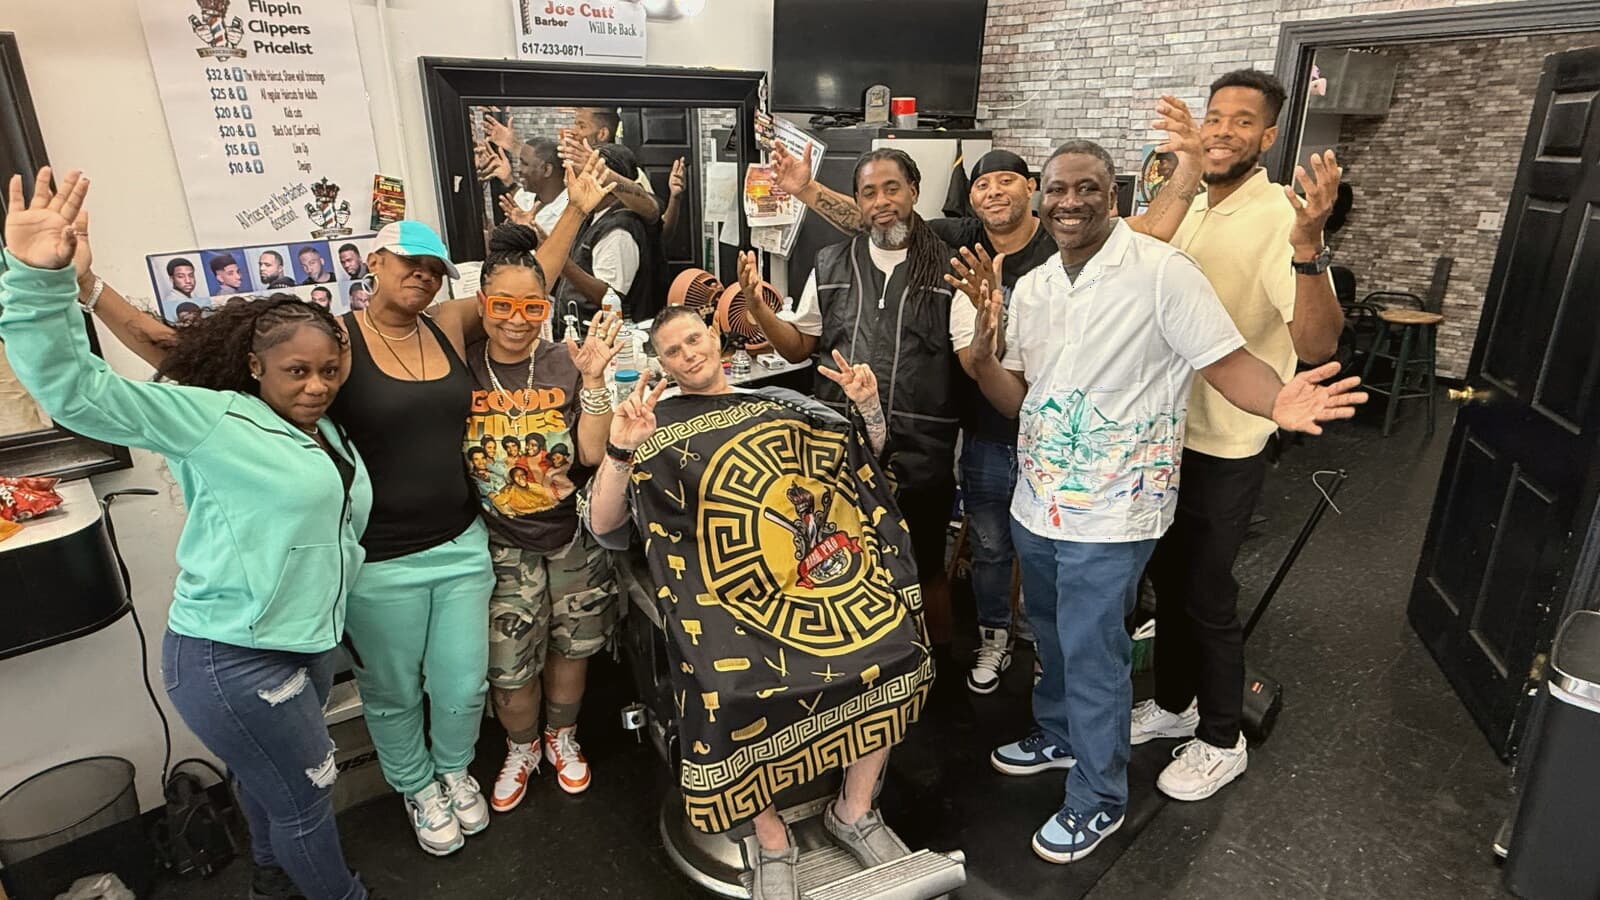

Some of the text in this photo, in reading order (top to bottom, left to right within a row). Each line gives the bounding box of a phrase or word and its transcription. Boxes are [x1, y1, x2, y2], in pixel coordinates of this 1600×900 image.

[248, 0, 302, 17] Flippin
[544, 0, 615, 19] Joe Cutt
[248, 20, 311, 37] Clippers
[534, 16, 568, 27] Barber
[588, 21, 637, 36] Will Be Back
[253, 40, 314, 55] Pricelist
[522, 42, 584, 57] 617-233-0871
[205, 67, 223, 82] $32
[210, 86, 227, 101] $25
[214, 106, 231, 120] $20
[219, 124, 236, 139] $20
[224, 143, 239, 157] $15
[228, 161, 244, 175] $10
[471, 387, 566, 412] GOOD
[466, 409, 567, 440] TIMES
